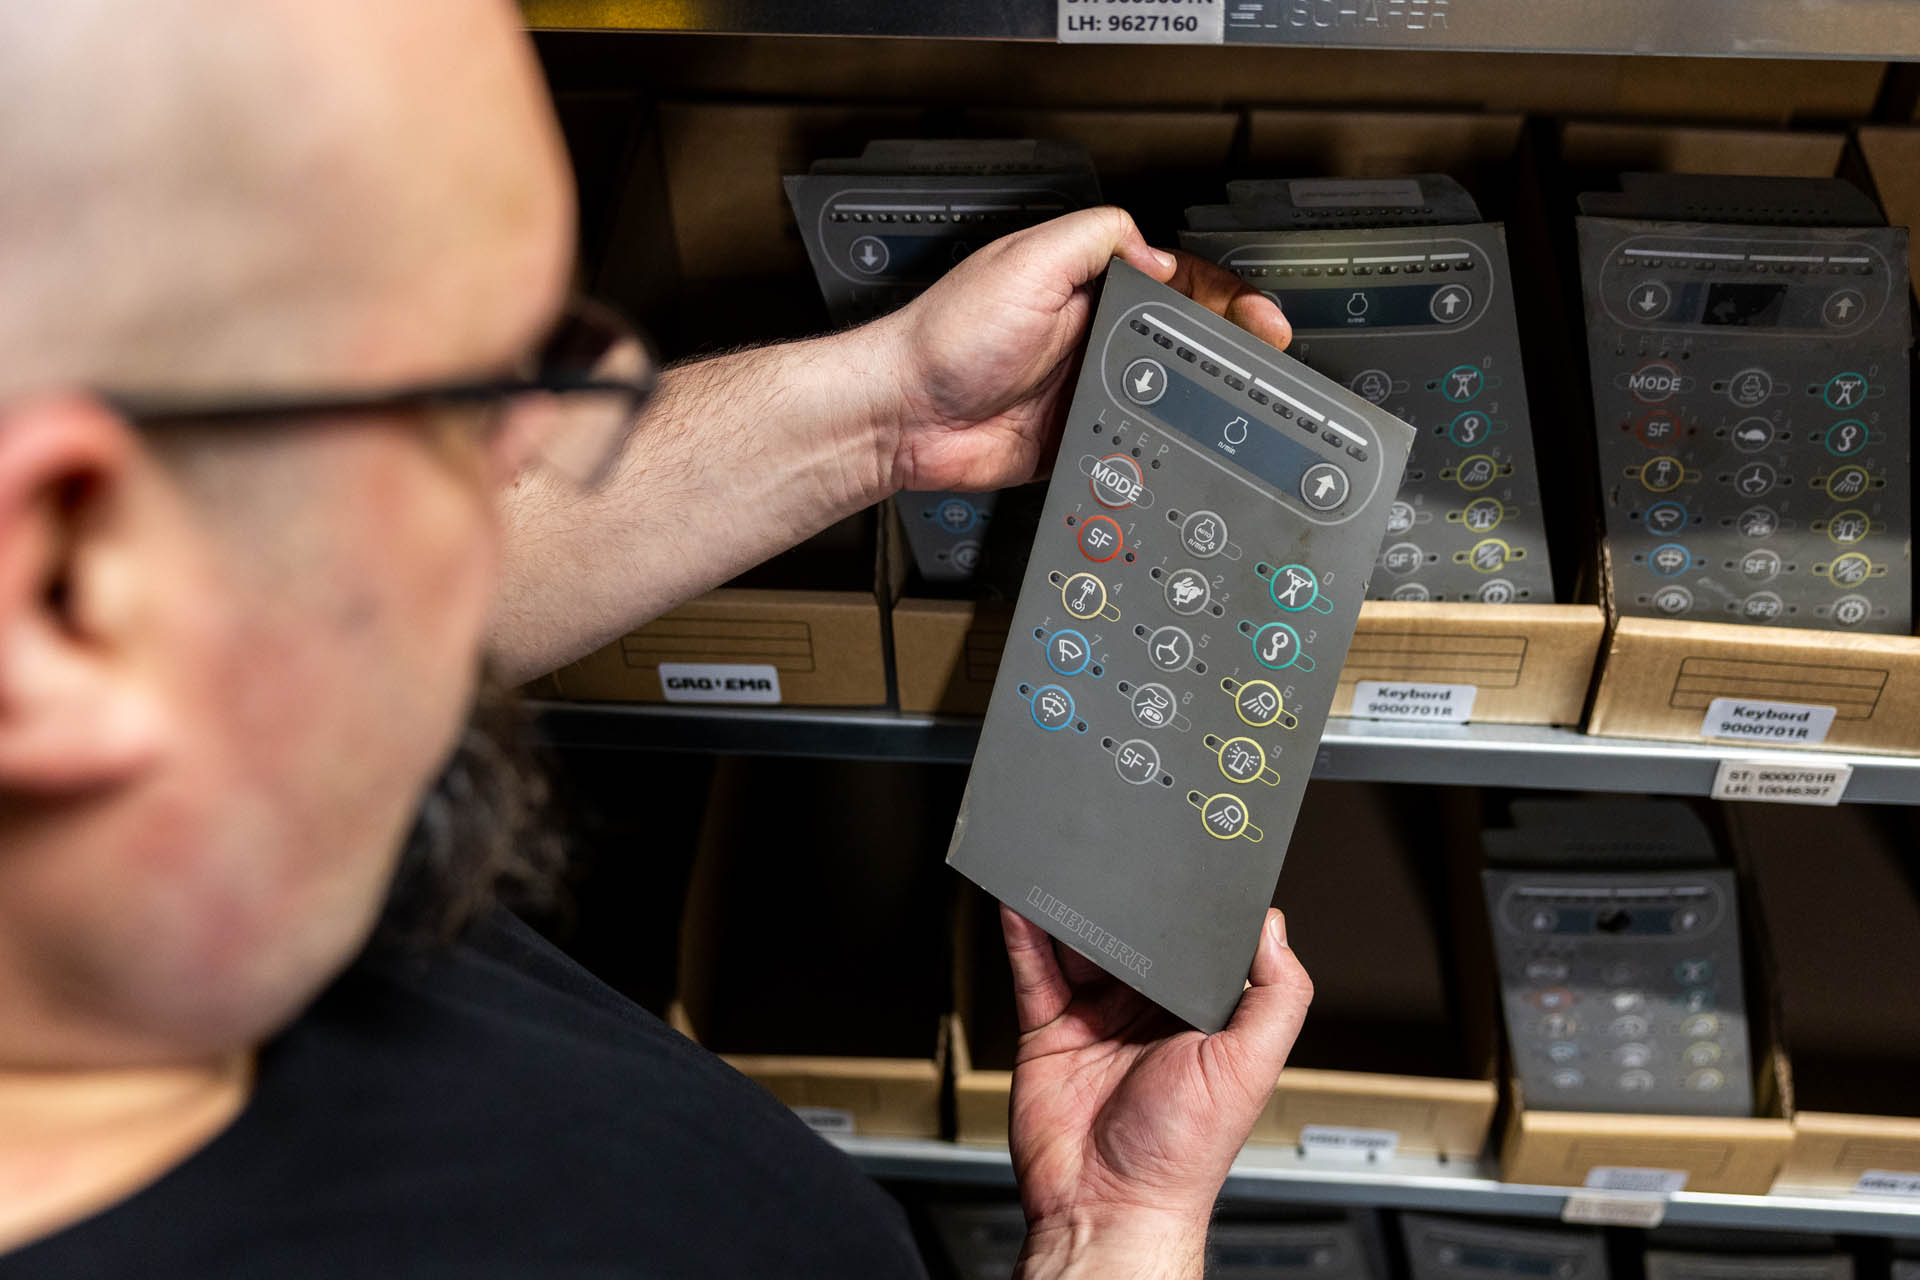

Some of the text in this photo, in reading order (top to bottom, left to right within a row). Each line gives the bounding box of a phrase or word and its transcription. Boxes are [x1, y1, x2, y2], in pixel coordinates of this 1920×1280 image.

[1067, 15, 1198, 32] LH: 9627160
[1628, 375, 1682, 391] MODE
[1097, 408, 1169, 457] L F E P
[1647, 422, 1671, 437] SF
[1091, 462, 1143, 501] MODE
[1087, 527, 1112, 548] SF
[1211, 575, 1225, 589] 2
[1198, 634, 1210, 649] 5
[1305, 630, 1317, 644] 3
[1182, 691, 1194, 704] 8
[1283, 685, 1295, 699] 6
[1378, 687, 1452, 700] Keybord
[1733, 706, 1811, 722] Keybord
[1720, 721, 1809, 738] 9000701R
[1270, 745, 1282, 759] 9
[1026, 885, 1153, 979] LIEBHERR
